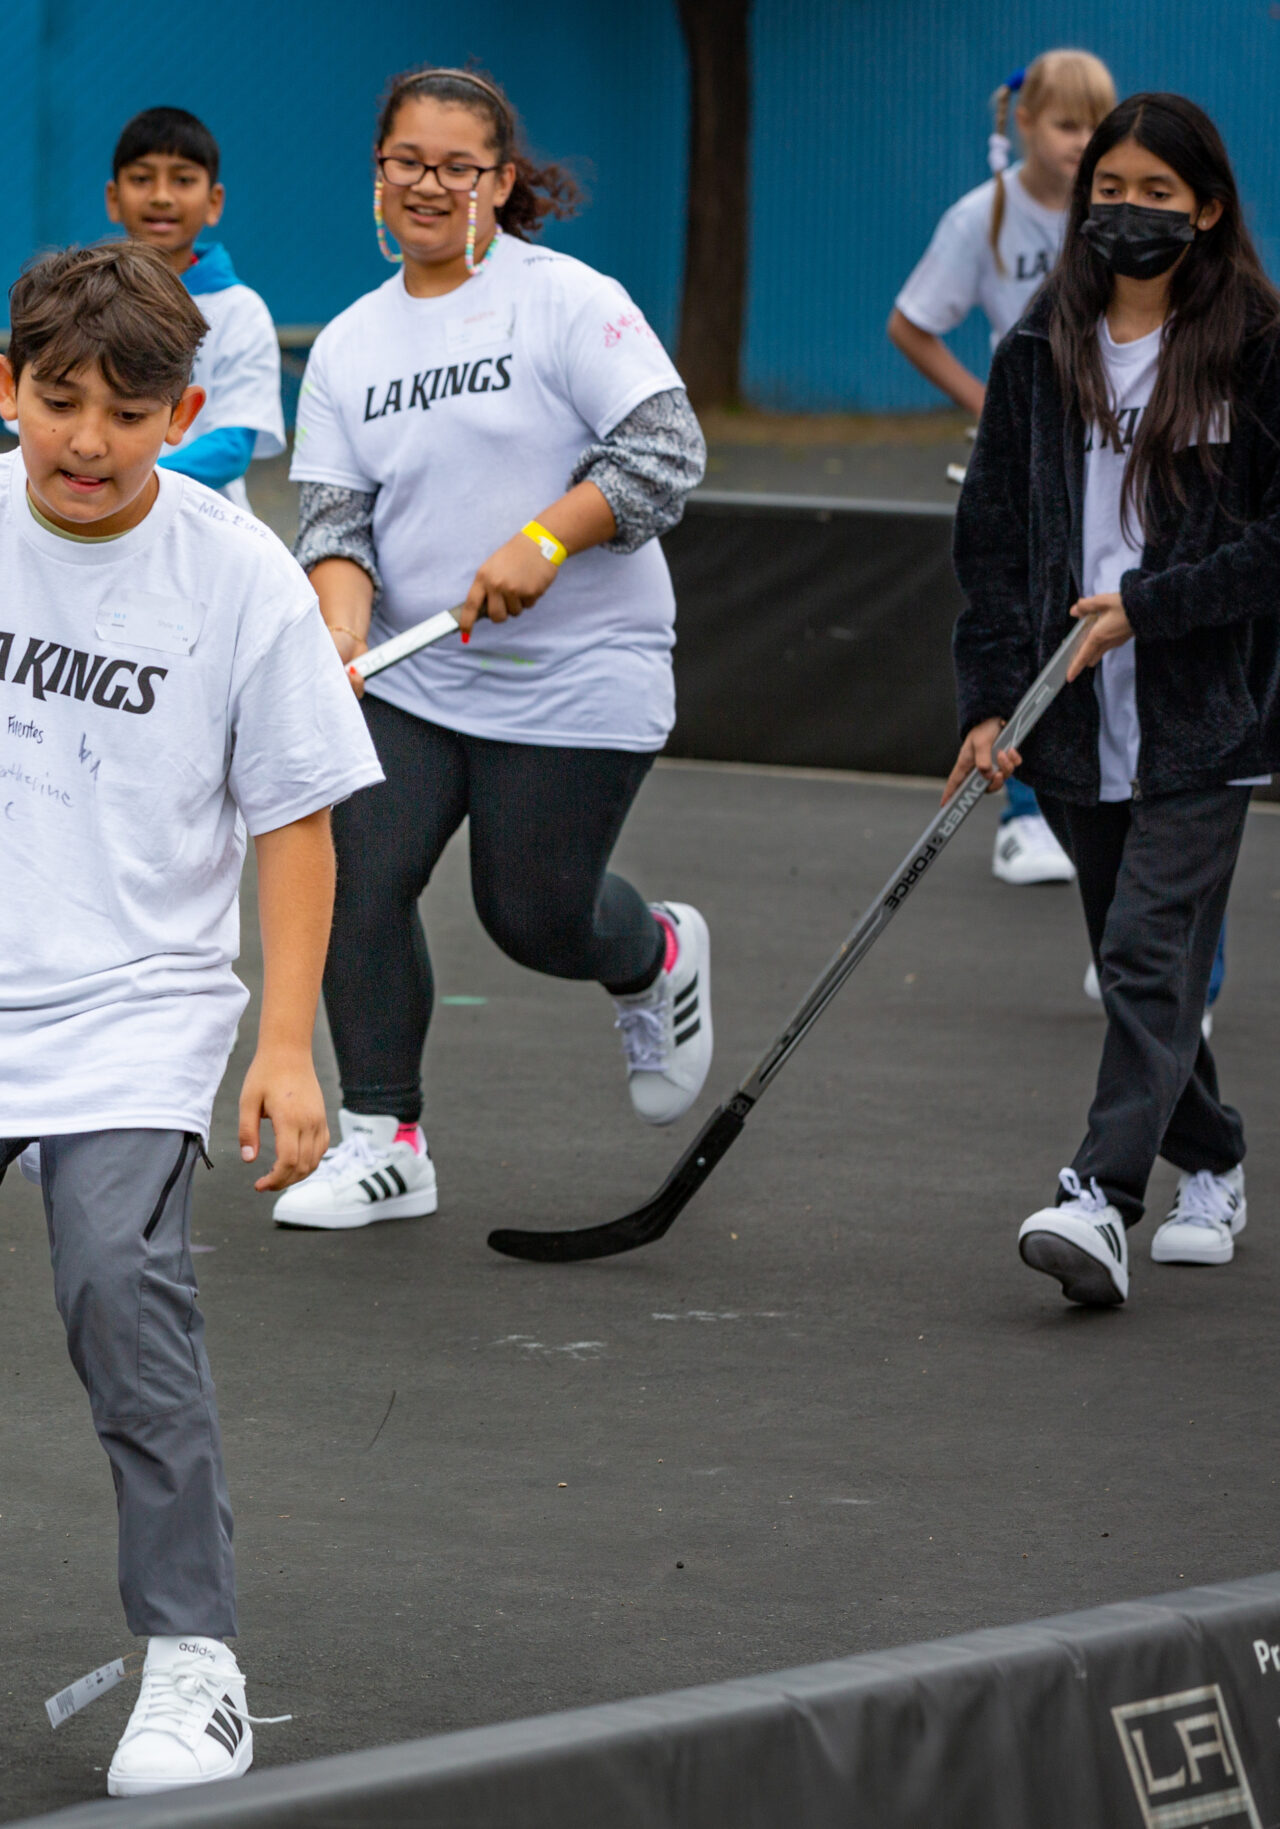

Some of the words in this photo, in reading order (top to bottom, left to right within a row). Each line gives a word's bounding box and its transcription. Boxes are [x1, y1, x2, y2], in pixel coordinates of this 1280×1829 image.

[364, 379, 403, 423] LA
[409, 353, 512, 411] KINGS
[11, 637, 169, 715] KINGS
[884, 845, 937, 911] FORCE
[1131, 1711, 1233, 1795] LA
